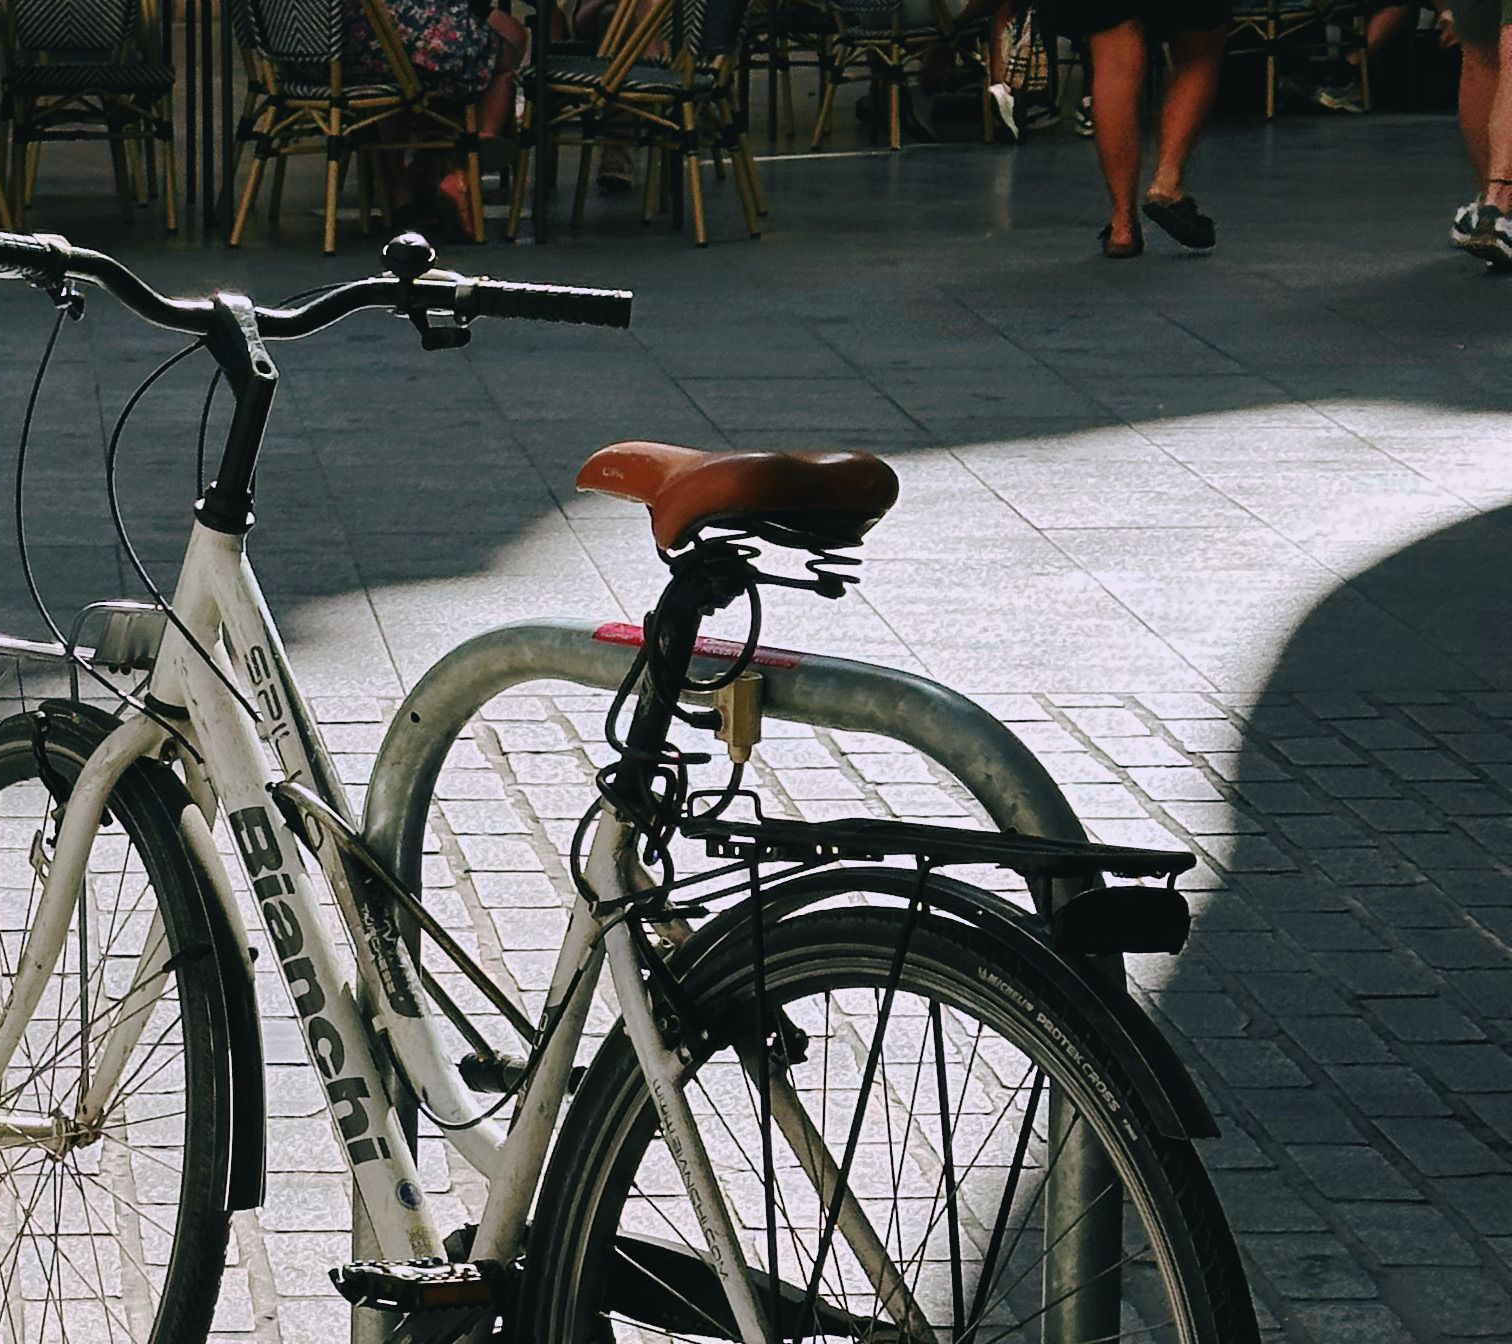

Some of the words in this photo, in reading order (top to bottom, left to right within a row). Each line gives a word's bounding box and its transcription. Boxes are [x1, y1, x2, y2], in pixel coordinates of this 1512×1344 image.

[230, 805, 391, 1165] Bianchi
[1036, 1012, 1085, 1065] PROTEK
[1081, 1062, 1121, 1113] CROSS
